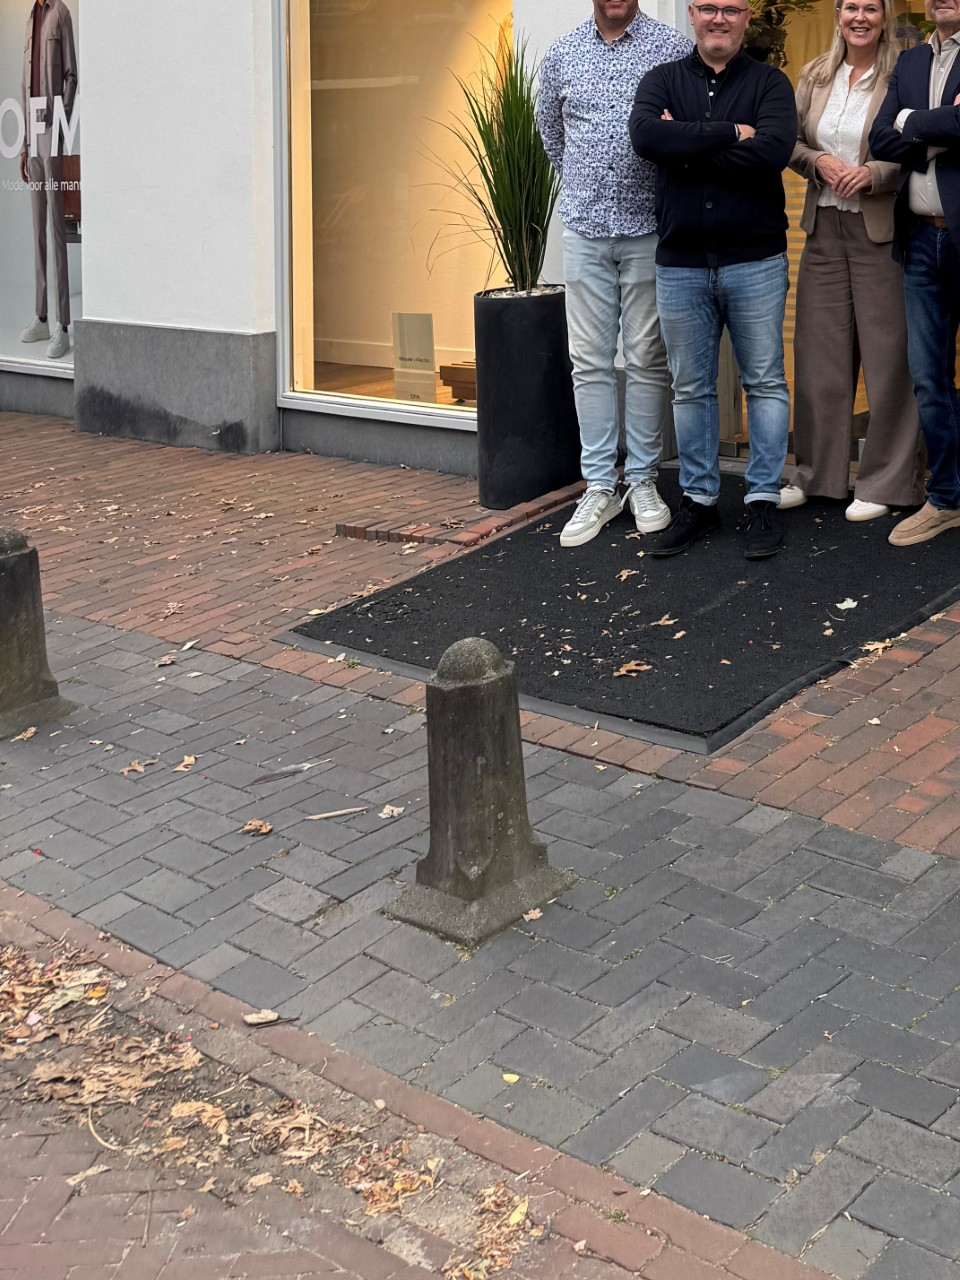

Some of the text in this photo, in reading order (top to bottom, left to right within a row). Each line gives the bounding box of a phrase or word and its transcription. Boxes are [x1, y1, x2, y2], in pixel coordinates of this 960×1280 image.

[3, 178, 81, 191] Mode voor alle man
